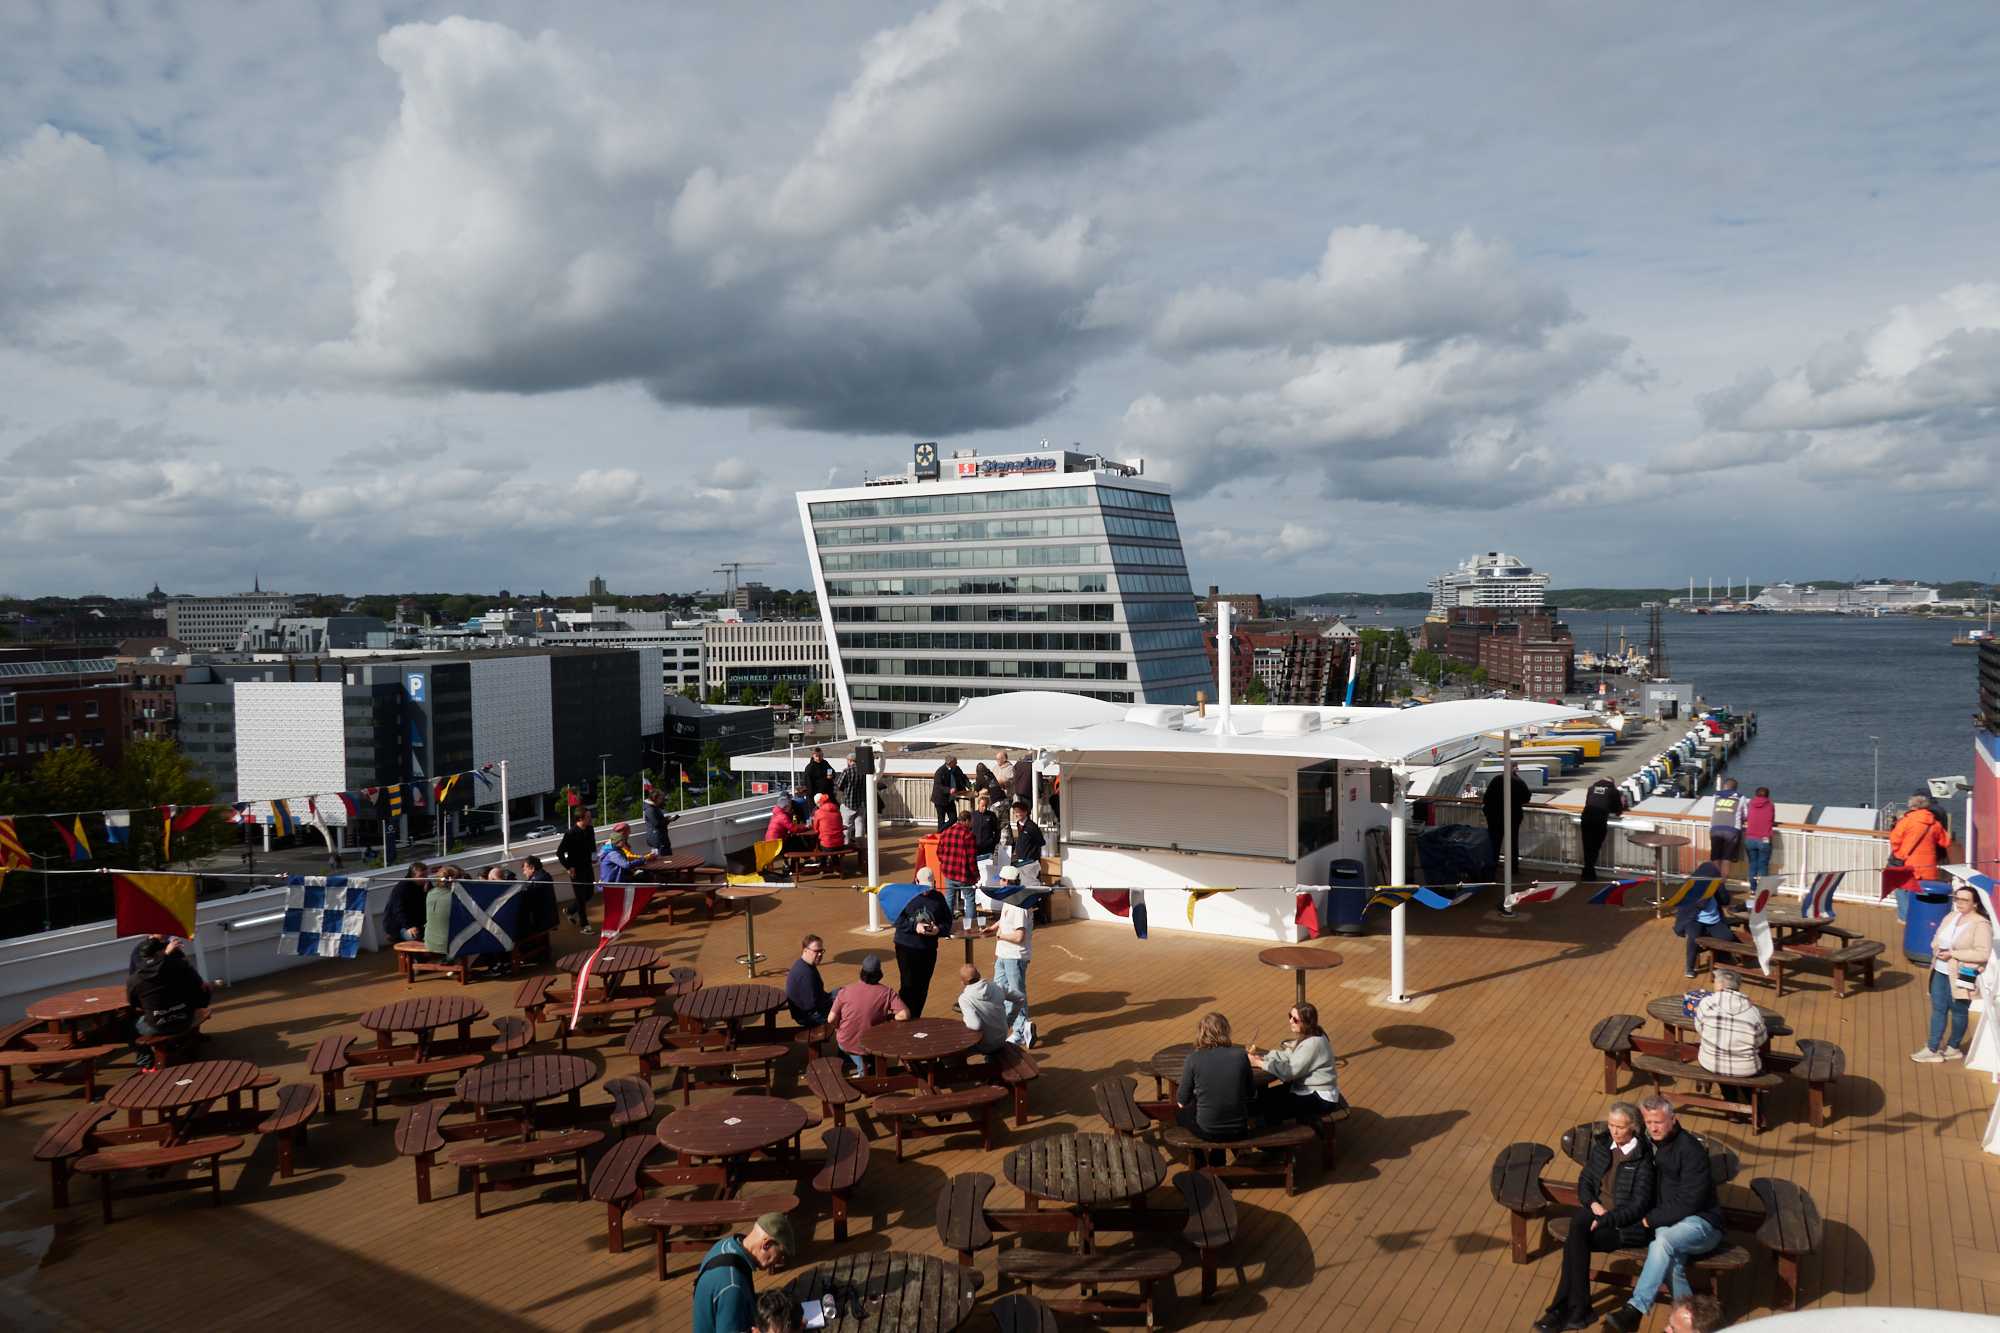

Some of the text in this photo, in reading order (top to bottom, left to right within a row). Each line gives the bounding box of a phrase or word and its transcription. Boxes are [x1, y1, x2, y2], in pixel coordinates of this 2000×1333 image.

[982, 456, 1055, 472] Stena Line
[410, 677, 422, 696] P
[1716, 798, 1736, 807] 46
